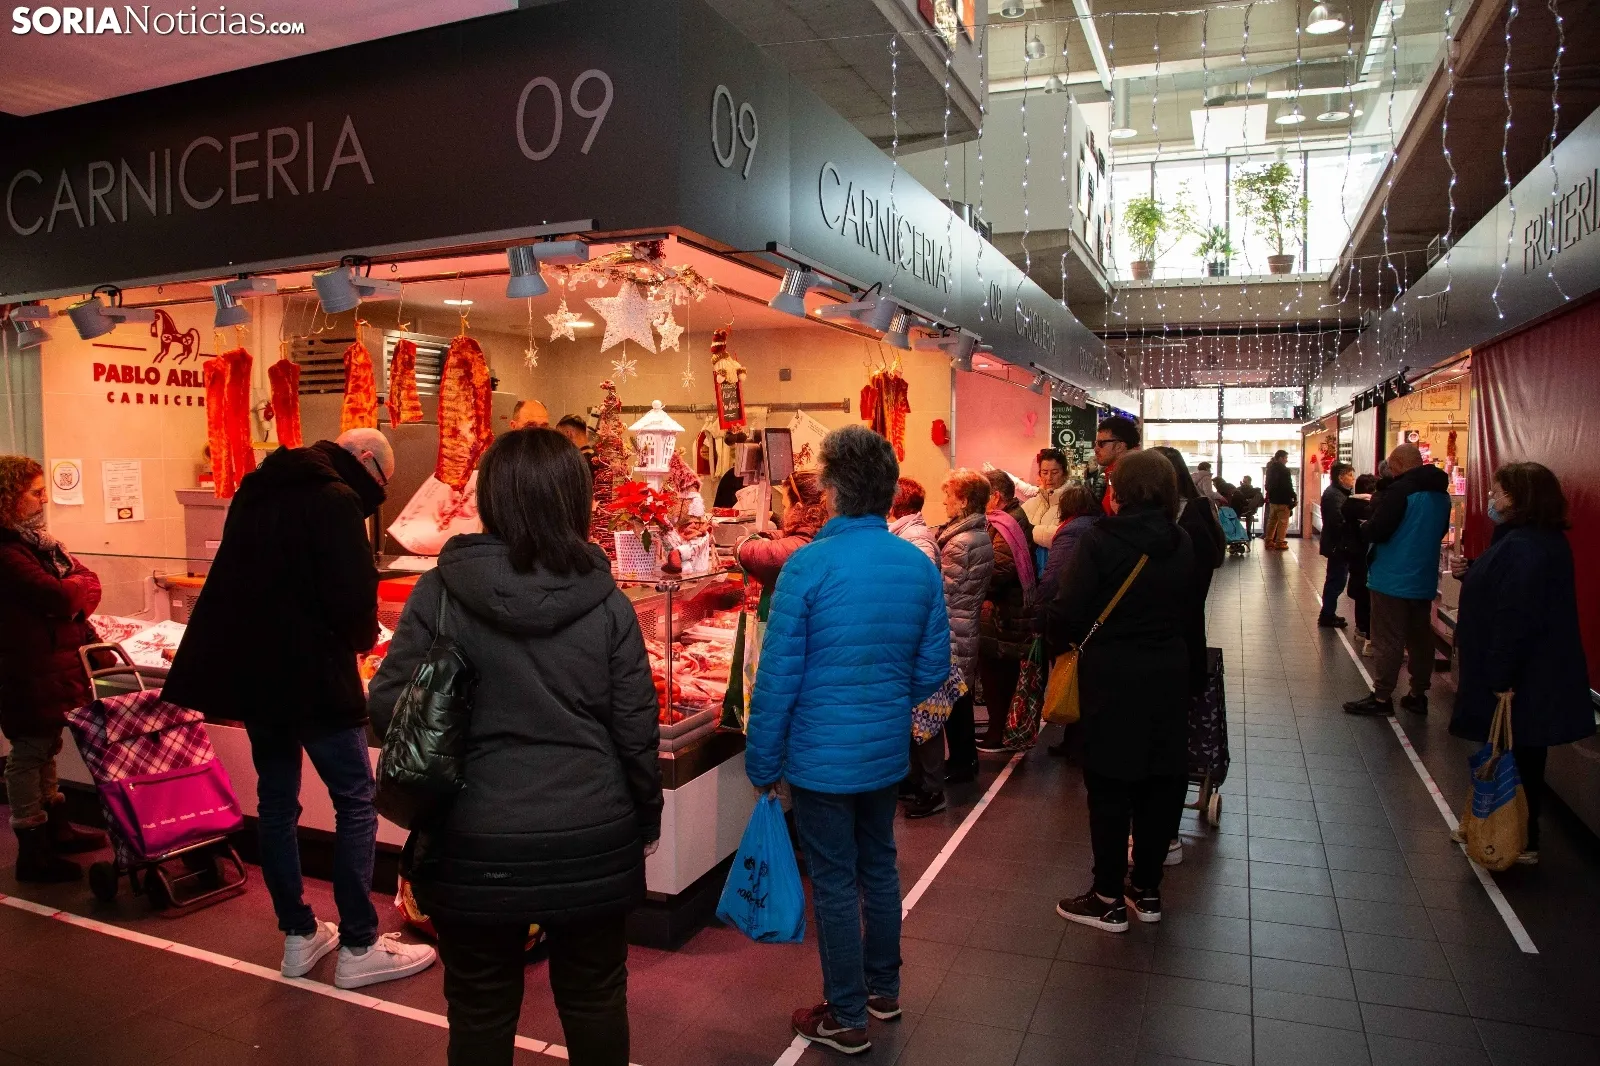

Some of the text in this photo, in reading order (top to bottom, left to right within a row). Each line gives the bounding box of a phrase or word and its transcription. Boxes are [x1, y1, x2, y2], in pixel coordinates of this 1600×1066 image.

[6, 68, 614, 236] CARNICERIA 09
[710, 84, 949, 294] 09 CARNICERIA
[1522, 167, 1600, 275] FRUTERI
[93, 362, 206, 388] PABLO ARL
[107, 391, 205, 407] CARNICER
